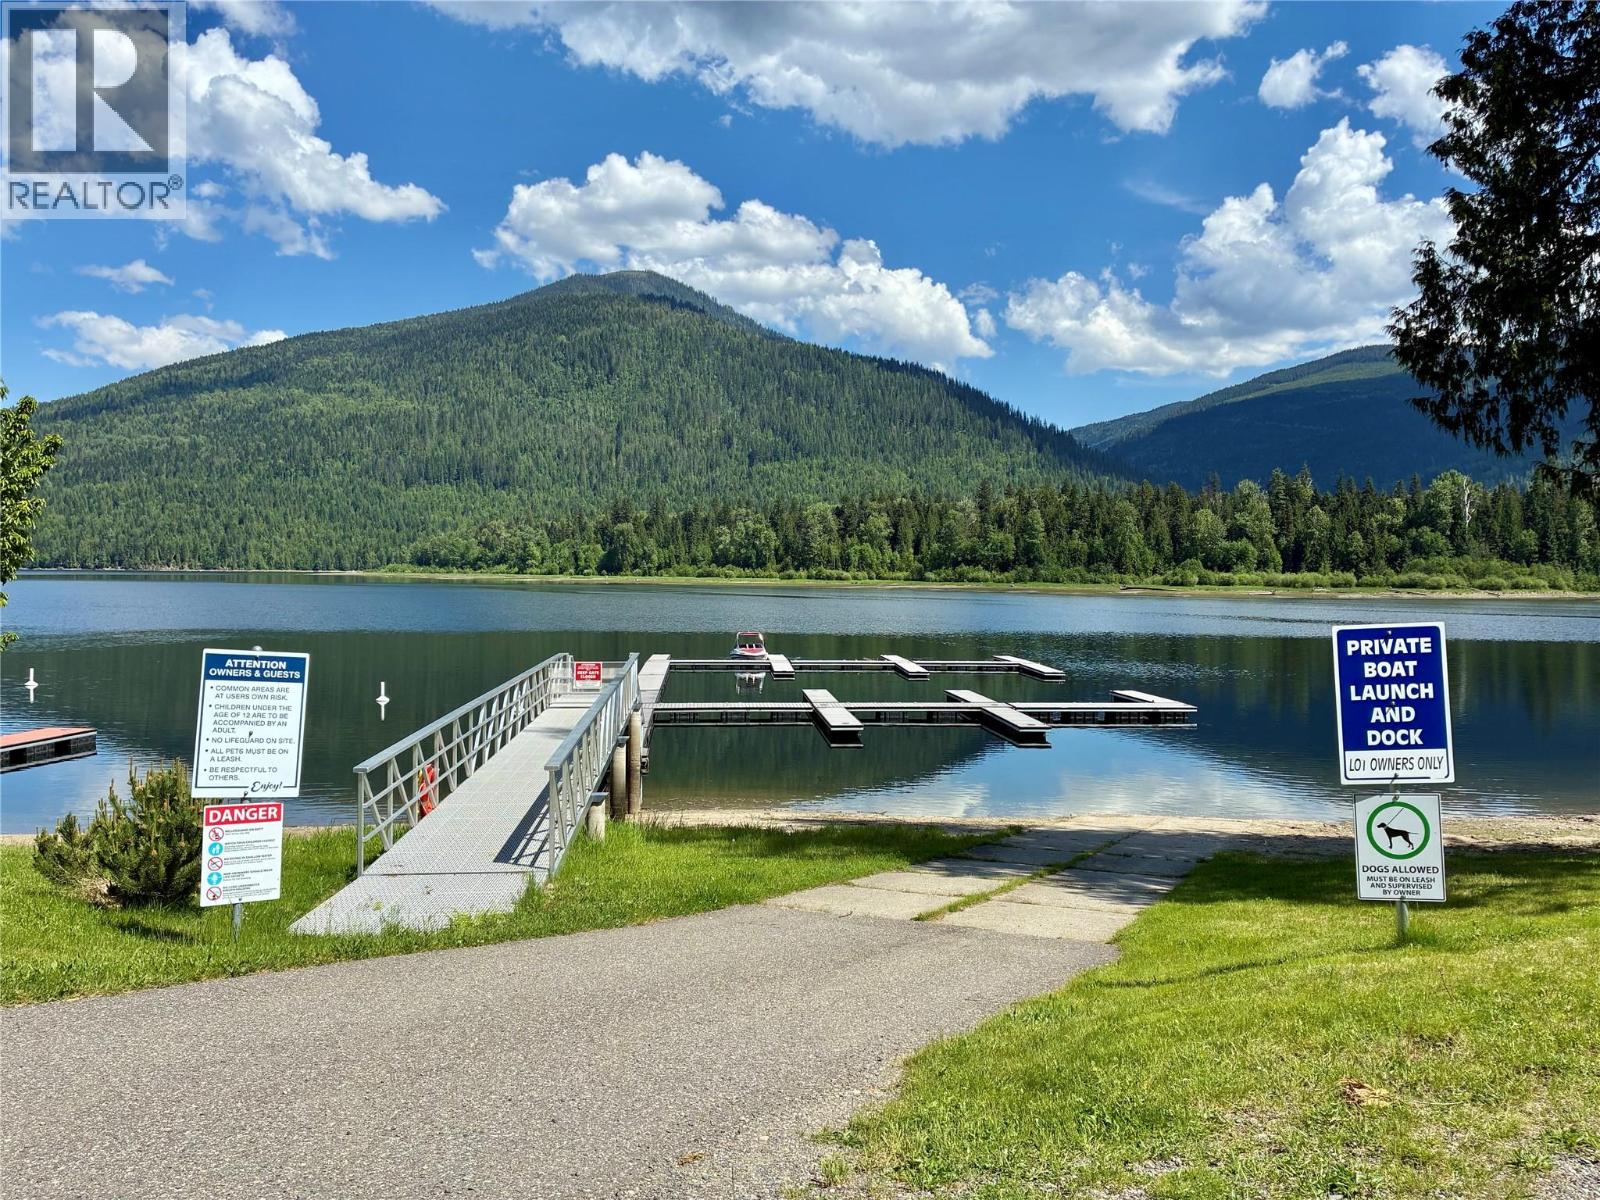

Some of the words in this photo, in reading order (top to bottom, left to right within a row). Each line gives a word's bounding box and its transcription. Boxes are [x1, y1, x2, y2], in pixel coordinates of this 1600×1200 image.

[1346, 637, 1432, 656] PRIVATE
[225, 659, 286, 669] ATTENTION
[1364, 661, 1418, 678] BOAT
[209, 668, 252, 677] OWNERS
[263, 670, 300, 679] GUESTS
[1350, 683, 1434, 701] LAUNCH
[1371, 707, 1415, 723] AND
[1367, 729, 1423, 746] DOCK
[1370, 757, 1414, 771] OWNERS
[1418, 756, 1443, 770] ONLY
[251, 781, 282, 792] Enjoy!
[209, 807, 278, 823] DANGER
[1362, 865, 1389, 873] DOGS
[1392, 866, 1439, 874] ALLOWED
